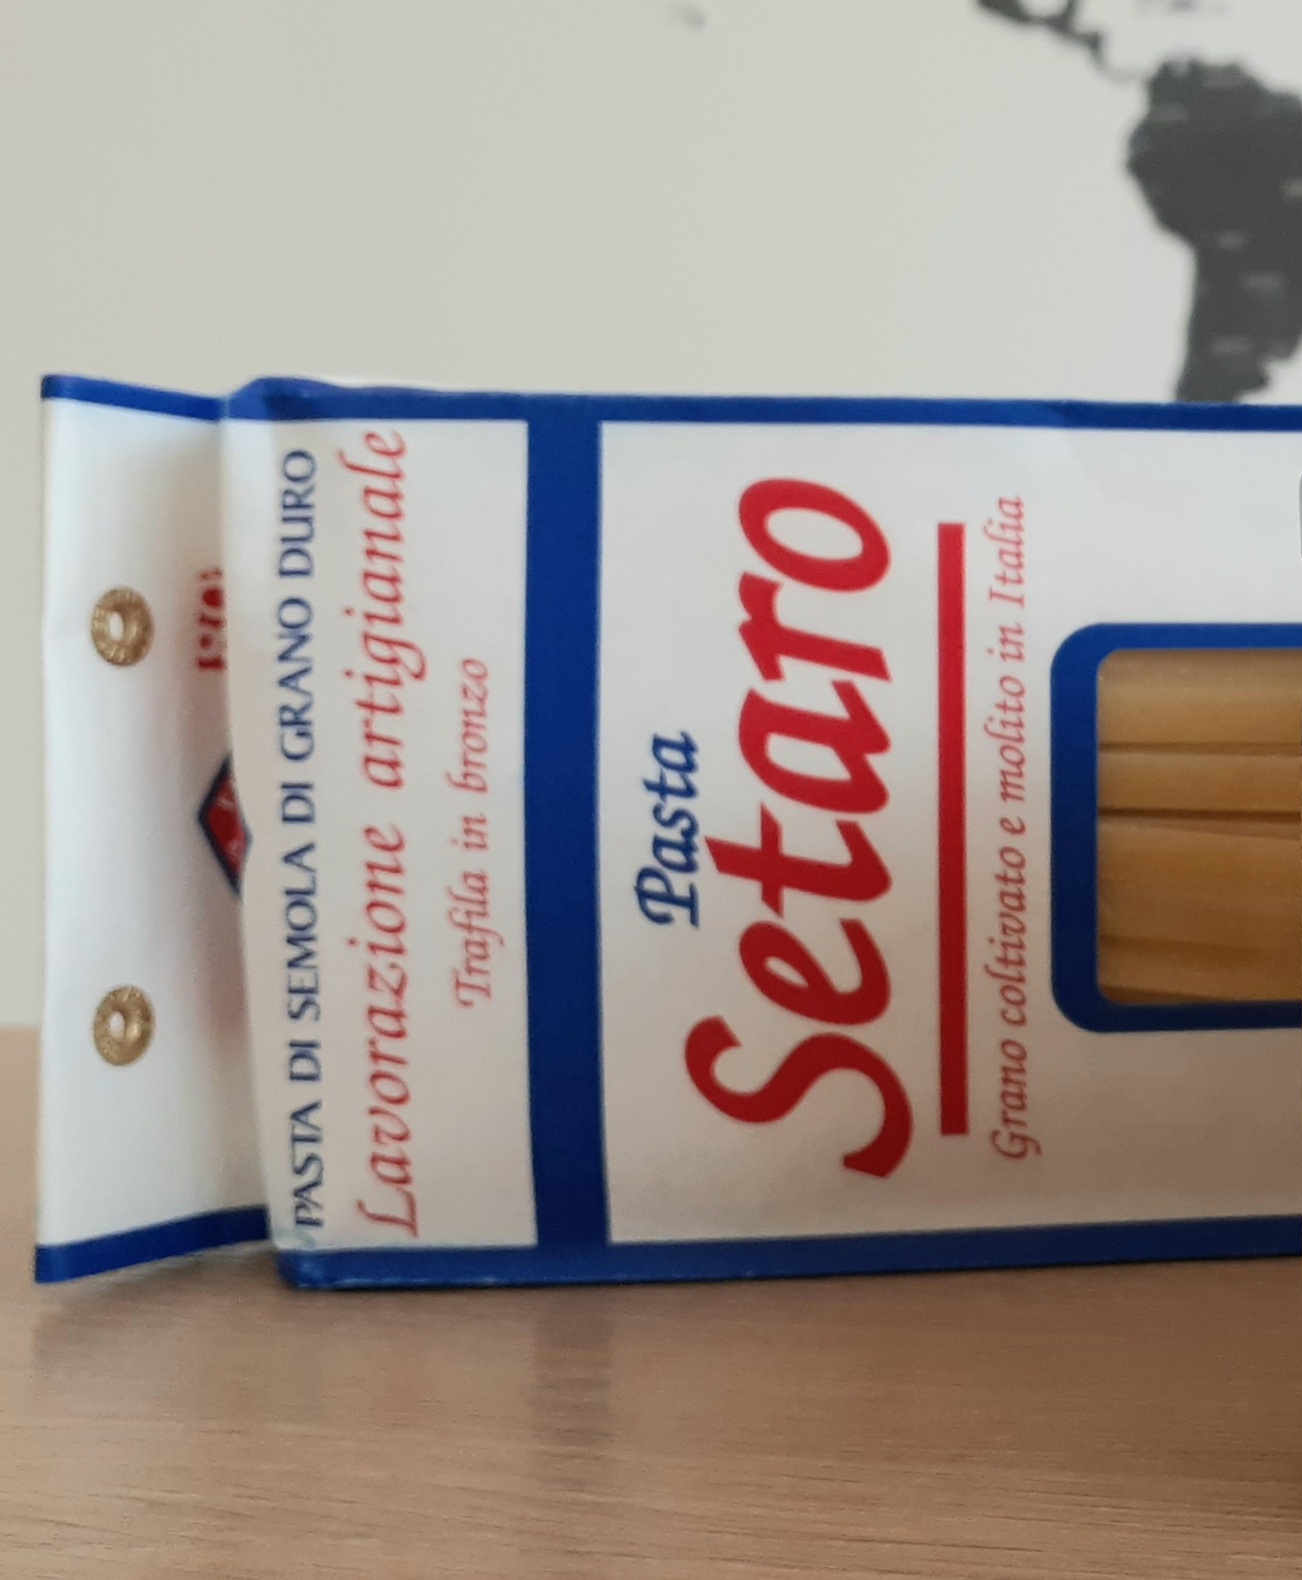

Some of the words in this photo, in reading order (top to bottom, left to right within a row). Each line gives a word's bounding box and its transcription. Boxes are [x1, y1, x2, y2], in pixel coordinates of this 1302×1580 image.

[278, 449, 317, 579] DURO
[983, 496, 1026, 608] Italia
[337, 431, 427, 789] artigianale
[986, 622, 1025, 663] in
[278, 596, 315, 761] GRANO
[446, 657, 489, 794] bronzo
[983, 675, 1026, 803] molito
[281, 781, 316, 825] DI
[452, 813, 489, 852] in
[633, 731, 700, 930] Pasta
[684, 477, 914, 1180] Setaro
[999, 815, 1026, 836] e
[282, 842, 321, 1022] SEMOLA
[448, 869, 504, 1008] Trafila
[984, 846, 1027, 1027] coltivato
[288, 1039, 321, 1082] DI
[347, 823, 420, 1239] Lavorazione
[290, 1101, 325, 1227] PASTA
[989, 1038, 1042, 1160] Grano
